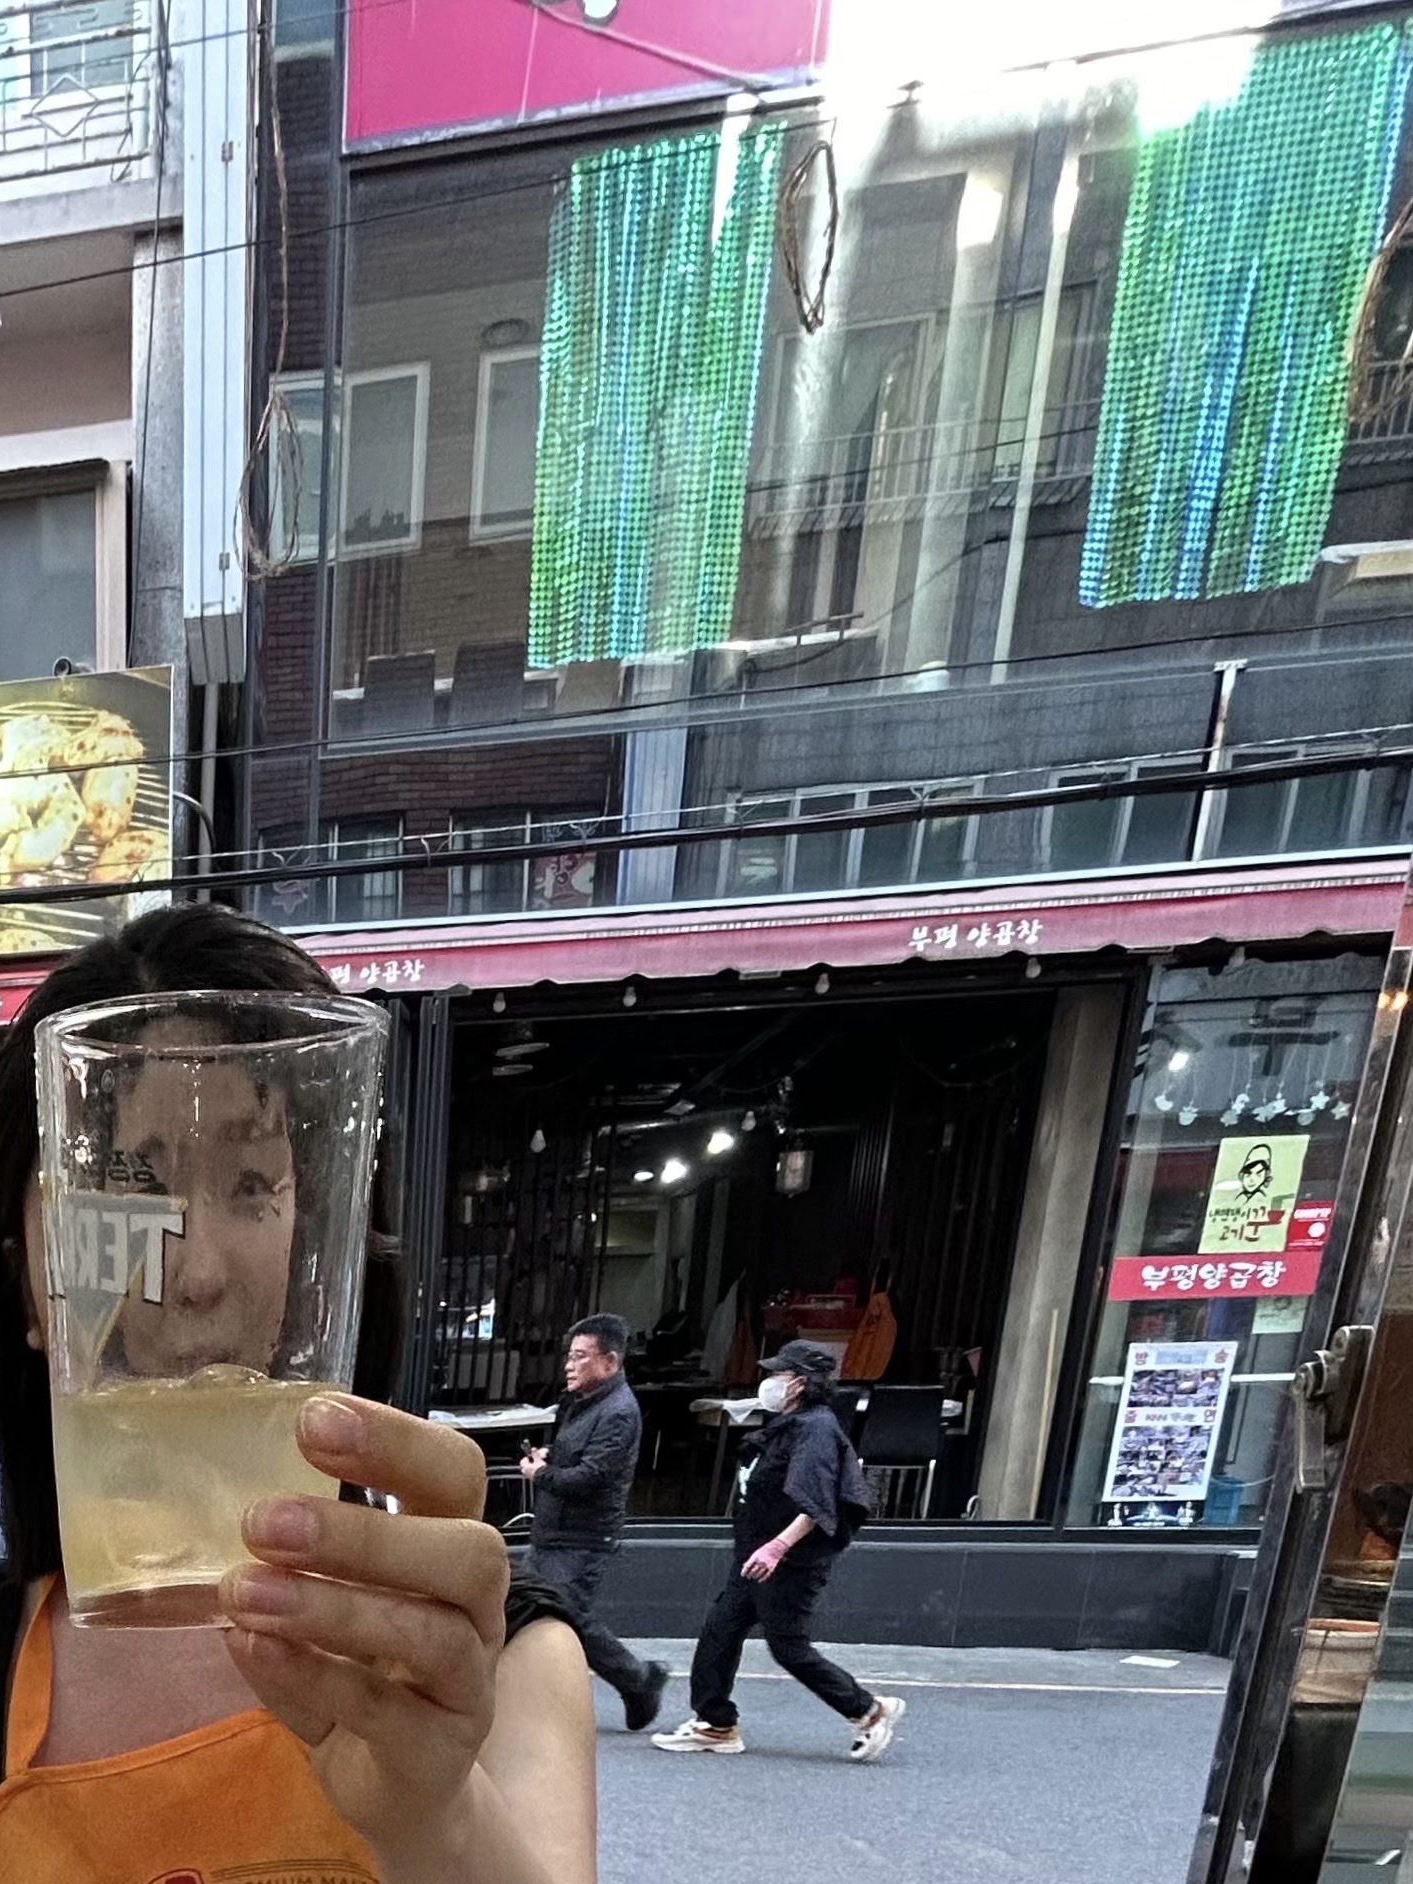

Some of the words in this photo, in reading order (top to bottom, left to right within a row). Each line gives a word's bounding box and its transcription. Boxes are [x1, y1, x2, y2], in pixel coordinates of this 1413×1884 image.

[909, 924, 958, 951] 부평
[966, 919, 1044, 948] 양곱창
[320, 962, 351, 984] 평
[359, 959, 425, 984] 양곱창
[1141, 1260, 1287, 1291] 부평양곱창
